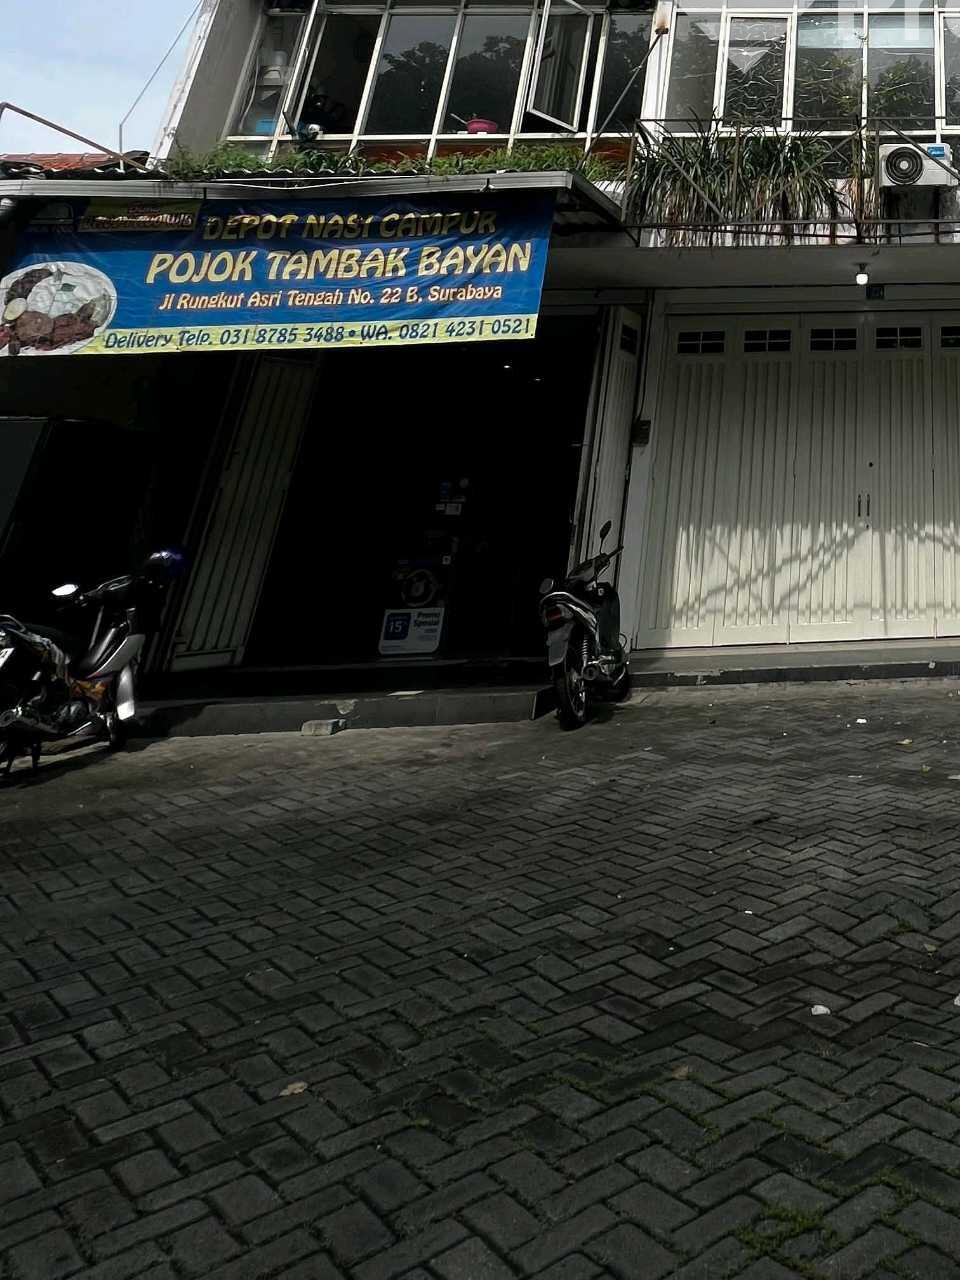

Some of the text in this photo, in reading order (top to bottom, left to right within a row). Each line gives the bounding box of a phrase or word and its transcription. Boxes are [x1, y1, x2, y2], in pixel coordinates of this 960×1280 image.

[202, 214, 294, 241] DEPOT
[306, 215, 374, 239] NASI
[380, 210, 498, 237] CAMPUR
[146, 242, 532, 284] POJOK TAMBAK BAYAN
[158, 292, 174, 310] Jl
[176, 290, 245, 309] Rungkut
[247, 289, 282, 307] Asri
[287, 288, 343, 307] Tengah
[348, 287, 375, 305] No.
[380, 287, 402, 304] 22
[428, 284, 503, 302] Surabaya
[105, 318, 531, 349] Delivery Telp. 031 8785 3488 WA. 0821 4231 0521
